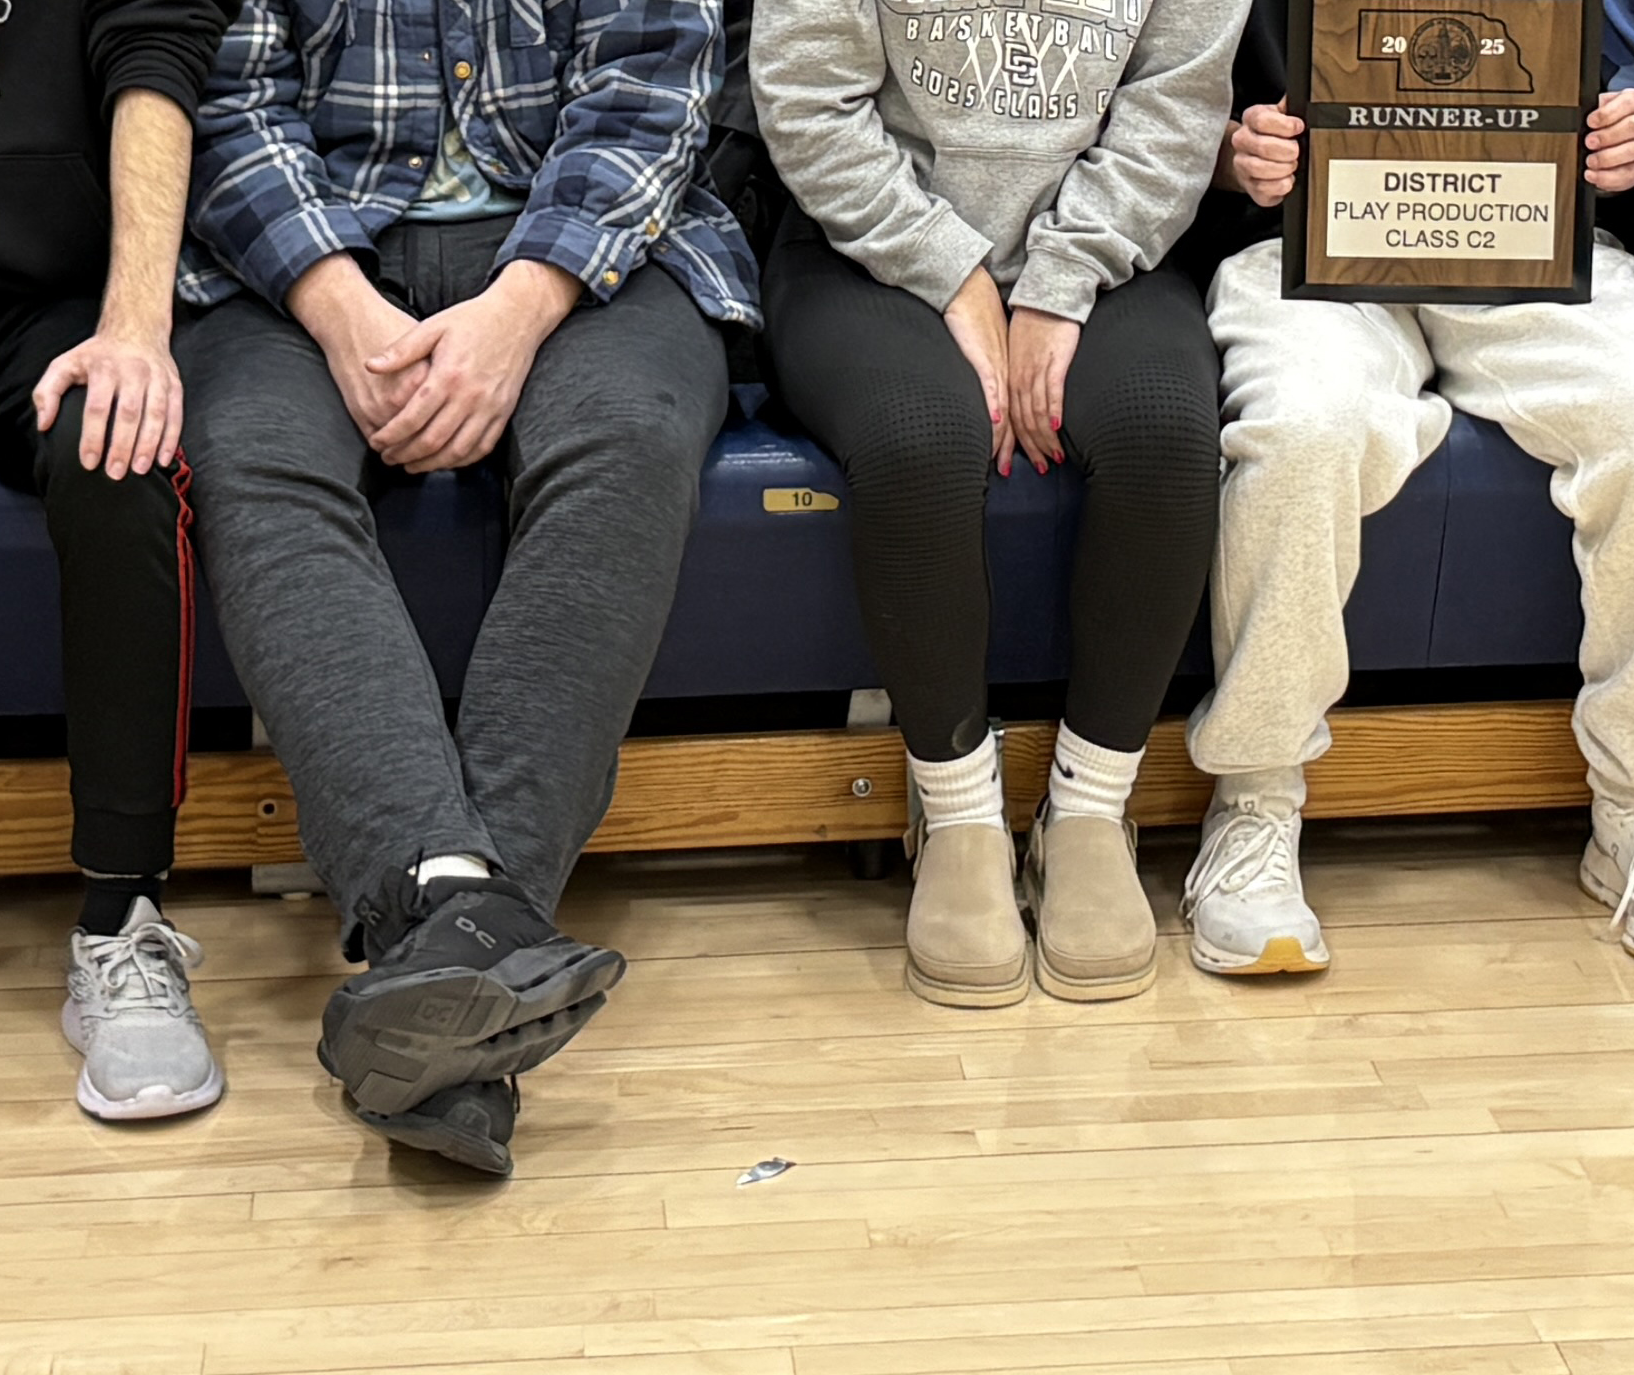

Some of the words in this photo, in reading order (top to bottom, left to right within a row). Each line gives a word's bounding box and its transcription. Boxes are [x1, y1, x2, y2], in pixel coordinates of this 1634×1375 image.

[906, 10, 1125, 61] BASKETBAL
[1381, 35, 1407, 54] 20
[1479, 38, 1506, 56] 25
[911, 56, 977, 108] 2025
[992, 87, 1078, 119] CLASS
[1348, 106, 1540, 128] RUNNER-UP
[1384, 172, 1503, 193] DISTRICT
[1333, 201, 1389, 220] PLAY
[1397, 202, 1549, 223] PRODUCTION
[1385, 229, 1459, 248] CLASS
[1466, 230, 1496, 249] C2
[792, 492, 813, 508] 10
